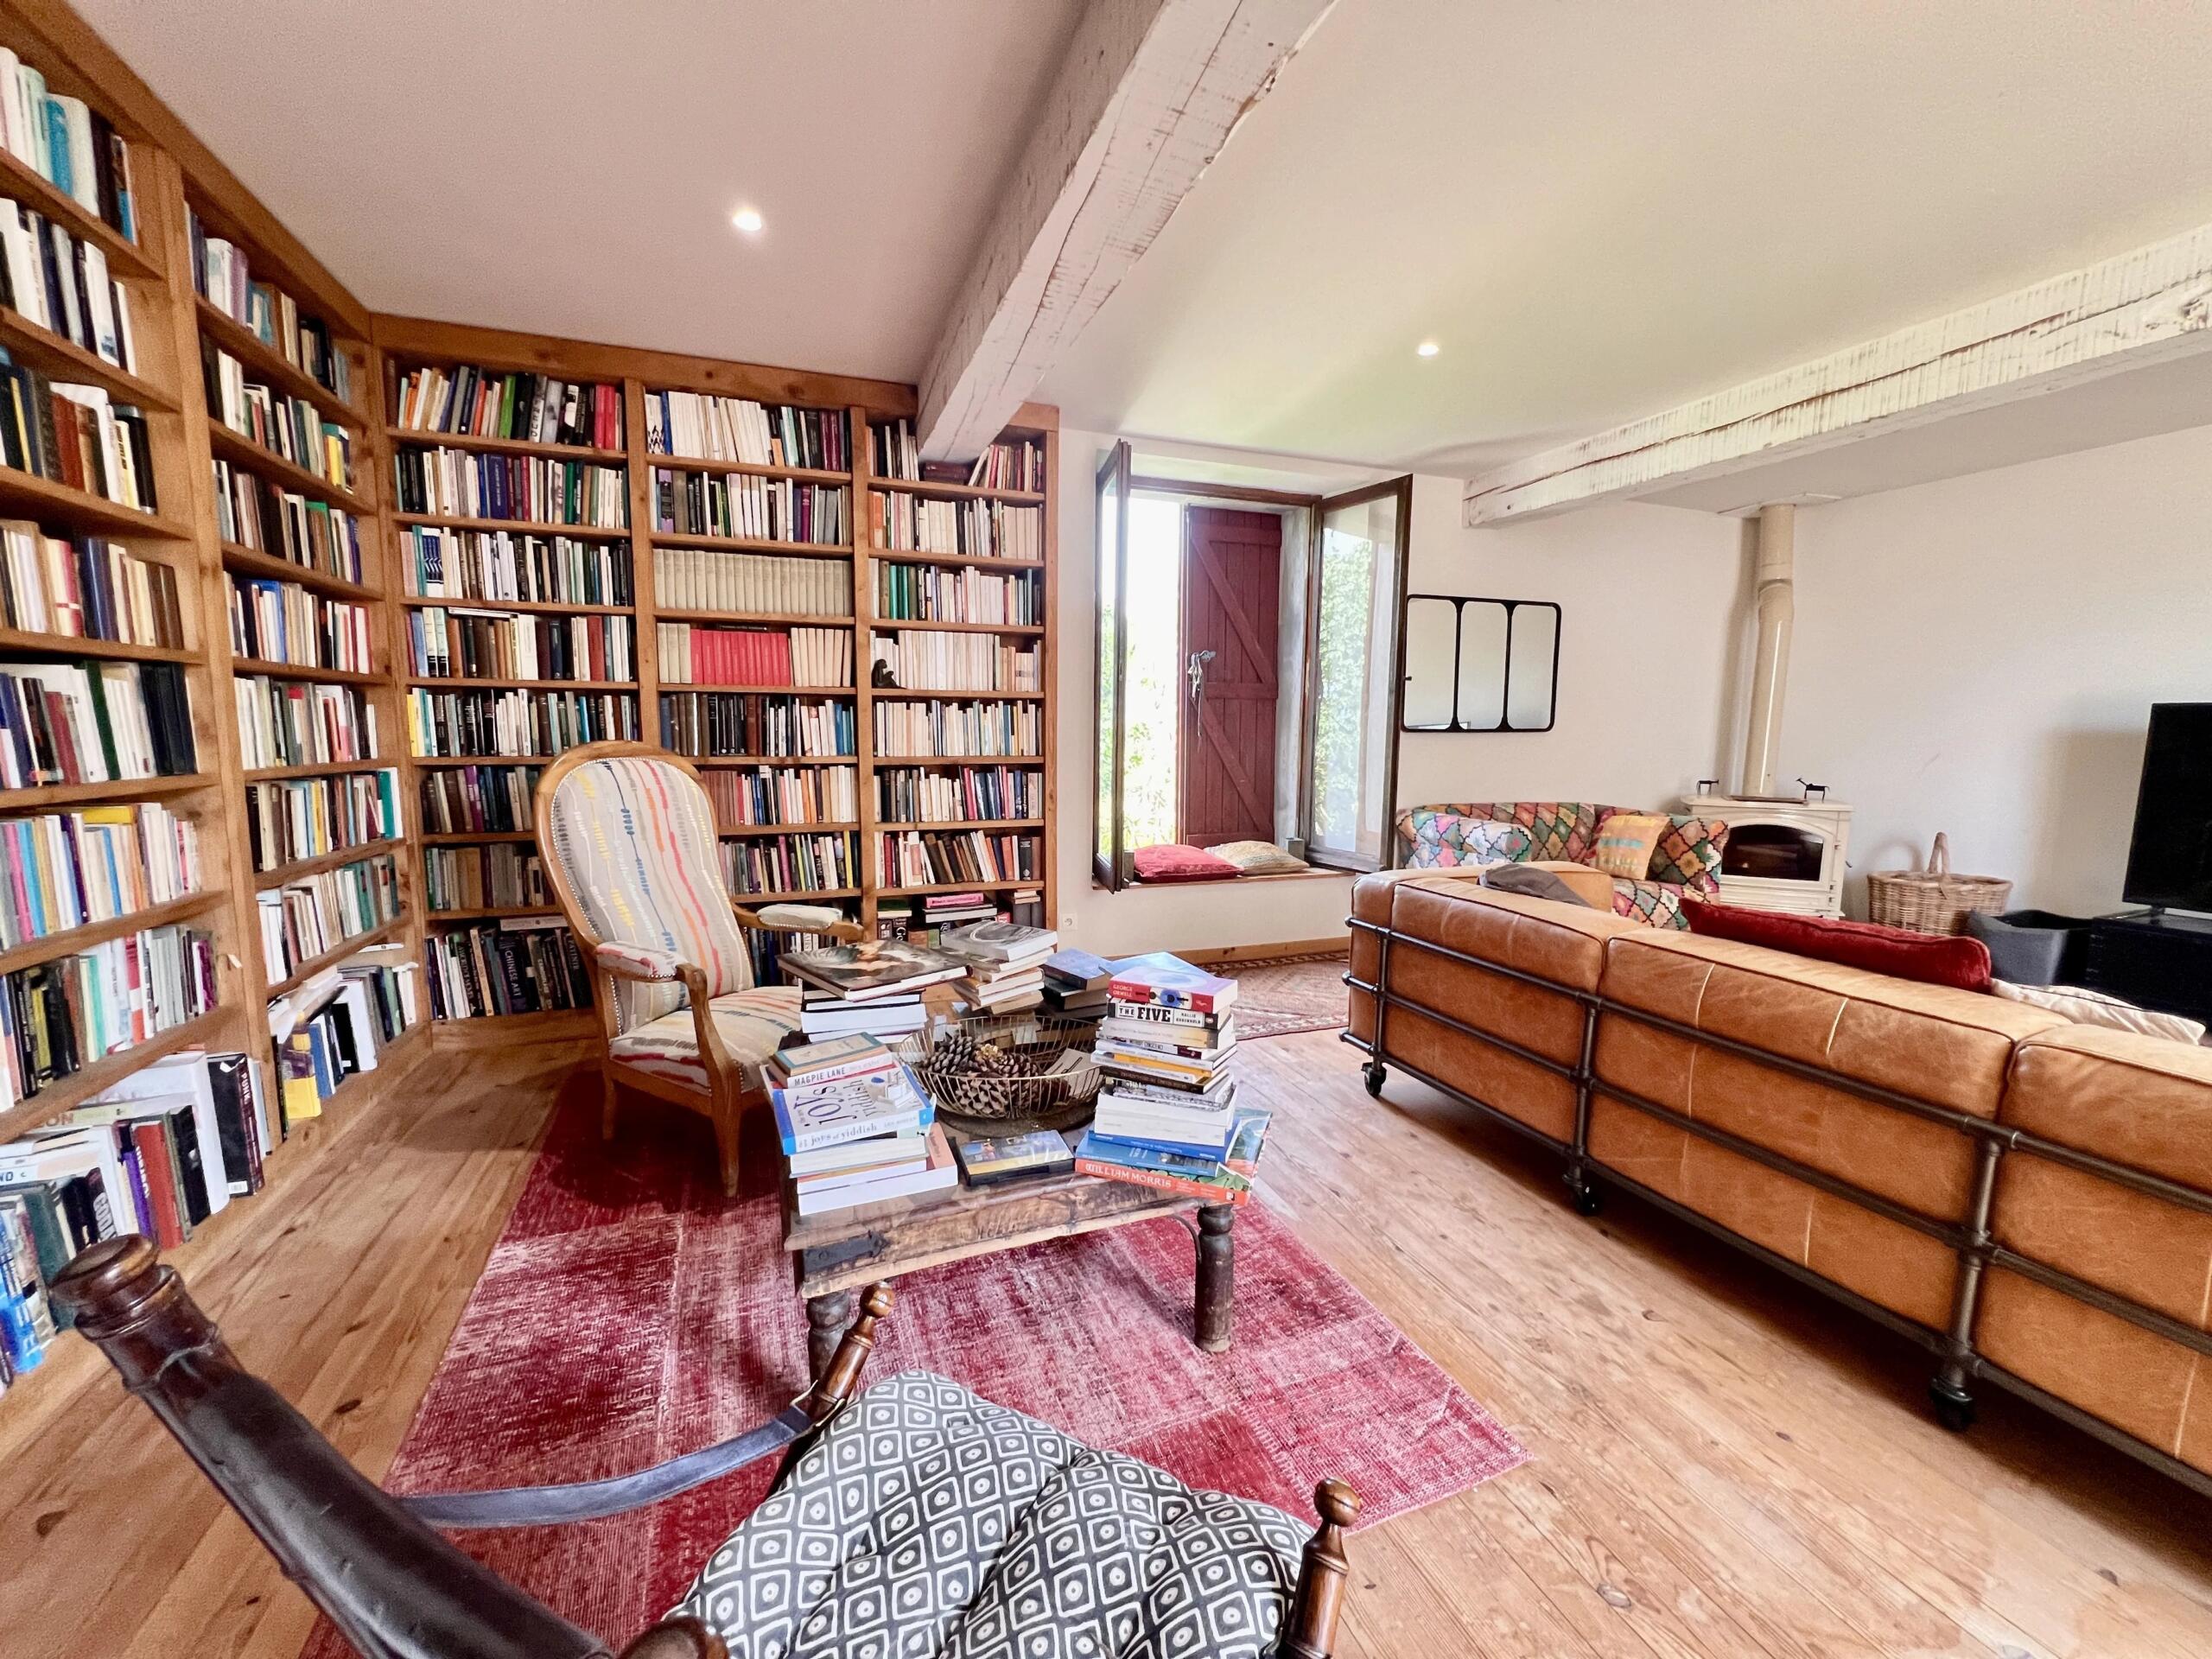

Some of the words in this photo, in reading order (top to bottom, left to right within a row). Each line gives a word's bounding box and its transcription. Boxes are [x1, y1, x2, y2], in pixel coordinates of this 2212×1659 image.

[505, 950, 518, 981] CHINESE
[512, 982, 522, 996] ART
[1137, 1007, 1171, 1023] FIVE
[794, 1073, 824, 1086] MAGPIE
[827, 1068, 846, 1078] LANE
[841, 1122, 878, 1141] yiddish
[1085, 1163, 1130, 1180] WILLIAM
[1131, 1171, 1172, 1188] MORRIS
